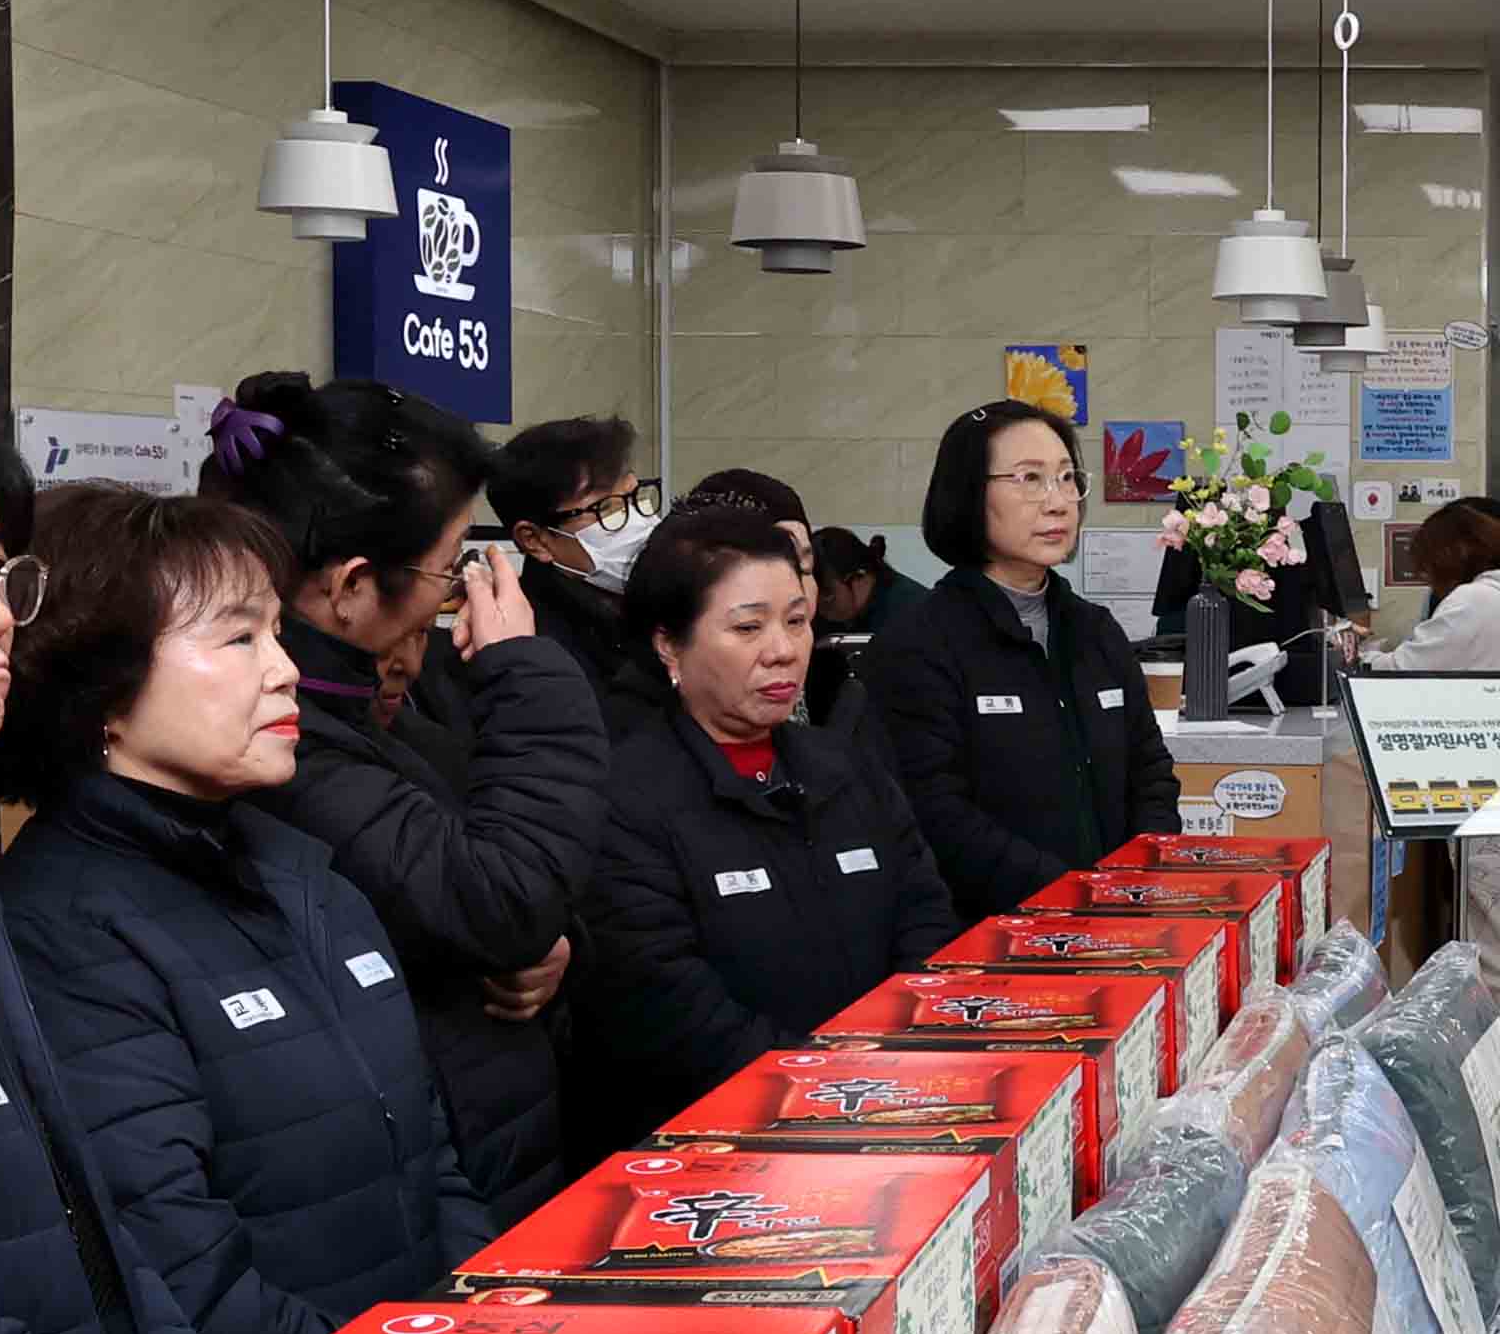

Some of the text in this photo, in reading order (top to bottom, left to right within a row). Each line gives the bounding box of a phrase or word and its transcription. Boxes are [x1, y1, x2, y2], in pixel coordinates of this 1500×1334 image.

[403, 312, 489, 371] Cafe 53
[1377, 732, 1487, 752] 설명절지원사업
[650, 1191, 788, 1241] 辛
